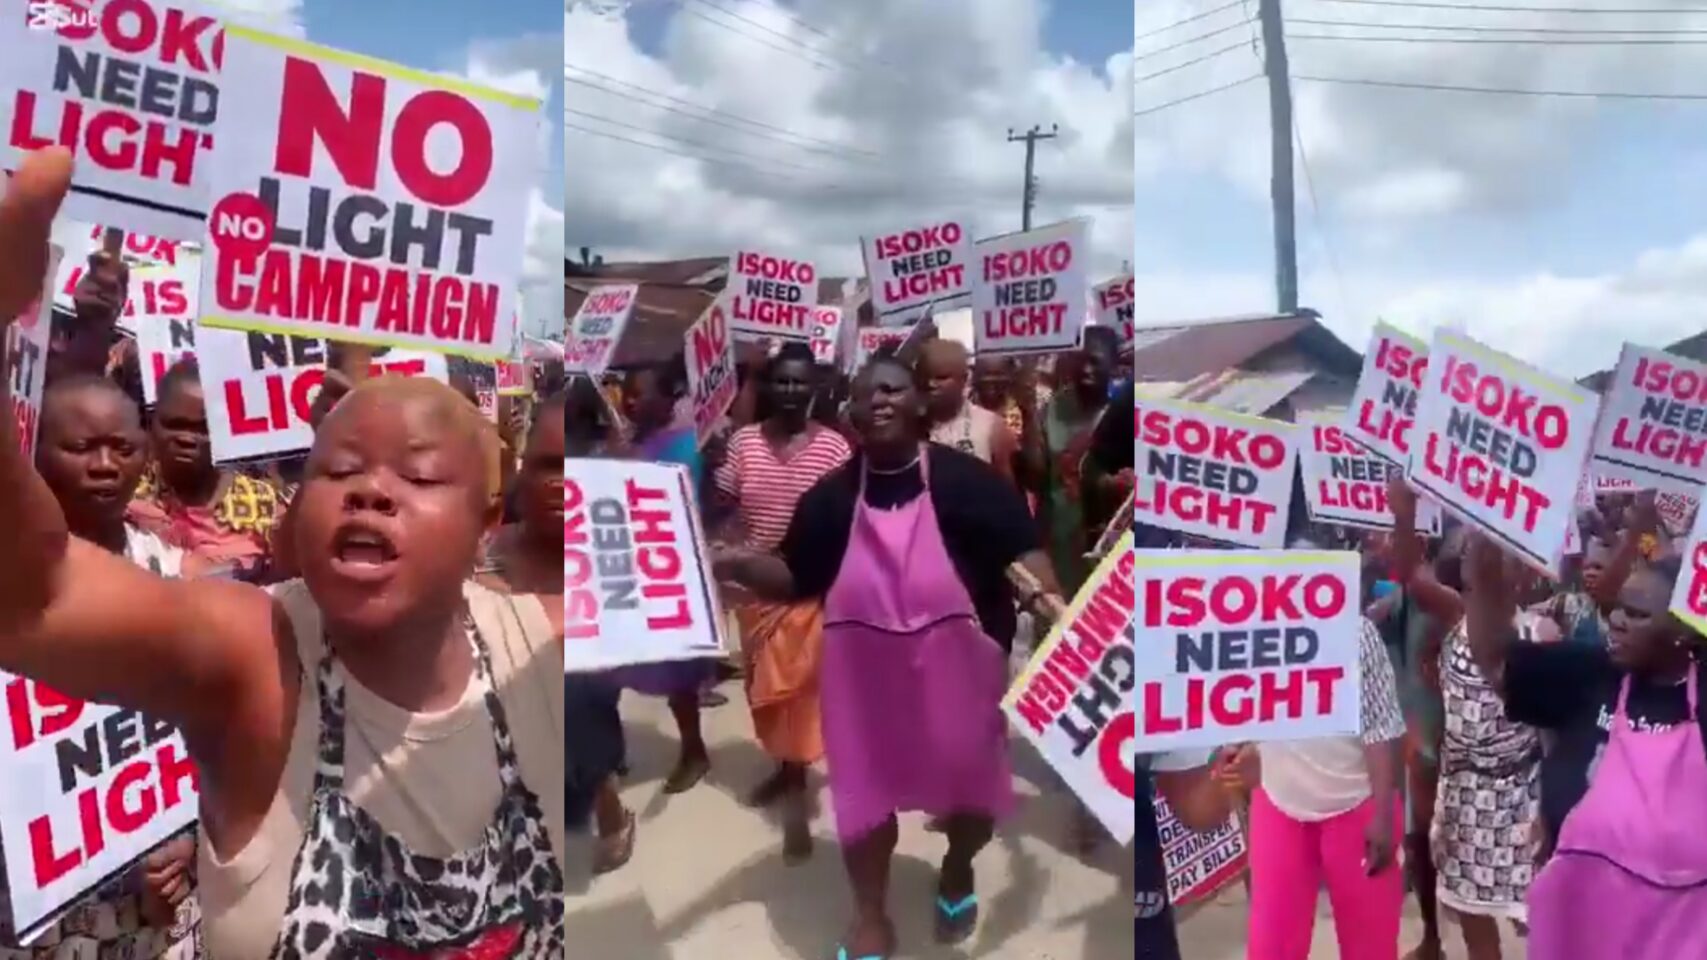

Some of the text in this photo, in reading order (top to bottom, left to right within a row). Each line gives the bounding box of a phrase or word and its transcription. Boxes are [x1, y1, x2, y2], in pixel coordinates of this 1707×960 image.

[53, 45, 219, 126] NEED
[10, 89, 213, 186] LIGH
[275, 56, 493, 207] NO
[218, 212, 266, 241] NO
[259, 177, 493, 276] LIGHT
[876, 223, 962, 260] ISOKO
[737, 251, 815, 284] ISOKO
[746, 279, 801, 302] NEED
[884, 265, 965, 304] LIGHT
[891, 249, 952, 278] NEED
[984, 241, 1071, 282] ISOKO
[215, 246, 499, 344] CAMPAIGN
[733, 296, 809, 329] LIGHT
[985, 304, 1068, 339] LIGHT
[995, 278, 1057, 306] NEED
[694, 306, 725, 377] NO
[1441, 353, 1569, 449] ISOKO
[1134, 406, 1286, 469] ISOKO
[1446, 406, 1537, 478] NEED
[1147, 450, 1258, 495] NEED
[1318, 479, 1395, 515] LIGH
[1424, 431, 1551, 534] LIGHT
[590, 498, 639, 610] NEED
[625, 477, 693, 631] LIGHT
[1145, 573, 1346, 628] ISOKO
[1176, 627, 1319, 673] NEED
[1144, 667, 1344, 735] LIGHT
[28, 744, 200, 890] LIGH
[1170, 836, 1242, 896] PAY BILLS
